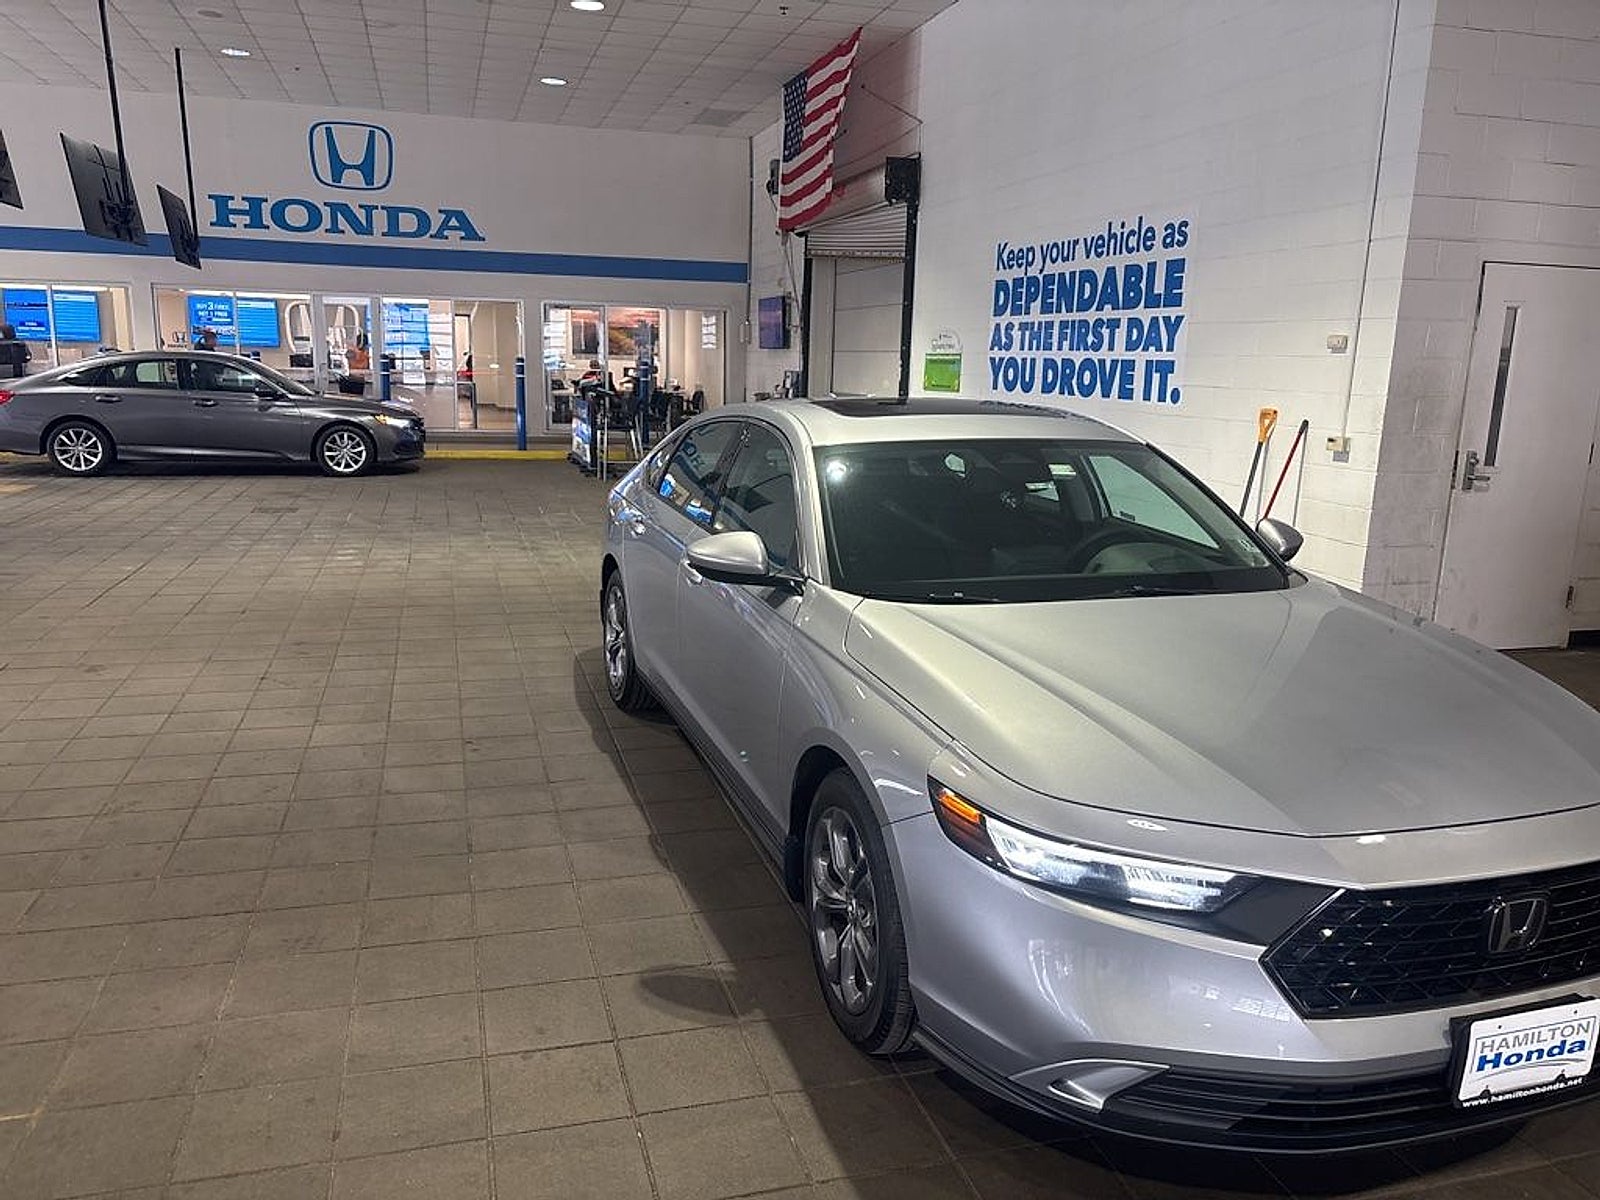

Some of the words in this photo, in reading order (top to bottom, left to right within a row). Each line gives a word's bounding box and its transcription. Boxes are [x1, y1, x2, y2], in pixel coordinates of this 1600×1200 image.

[208, 194, 486, 241] HONDA
[996, 241, 1036, 276] Keep
[1040, 238, 1079, 274] your
[1084, 216, 1156, 259] vehicle
[1162, 220, 1189, 249] as
[993, 258, 1186, 317] DEPENDABLE
[990, 322, 1016, 352] AS
[1018, 320, 1054, 352] THE
[1057, 318, 1120, 352] FIRST
[1125, 315, 1185, 352] DAY
[990, 357, 1037, 394] YOU
[1041, 358, 1136, 401] DROVE
[1143, 359, 1181, 405] IT.
[1476, 1039, 1586, 1072] Honda
[1480, 1021, 1591, 1054] HAMILTON
[1462, 1077, 1582, 1107] www.hamiltonhonda.net
